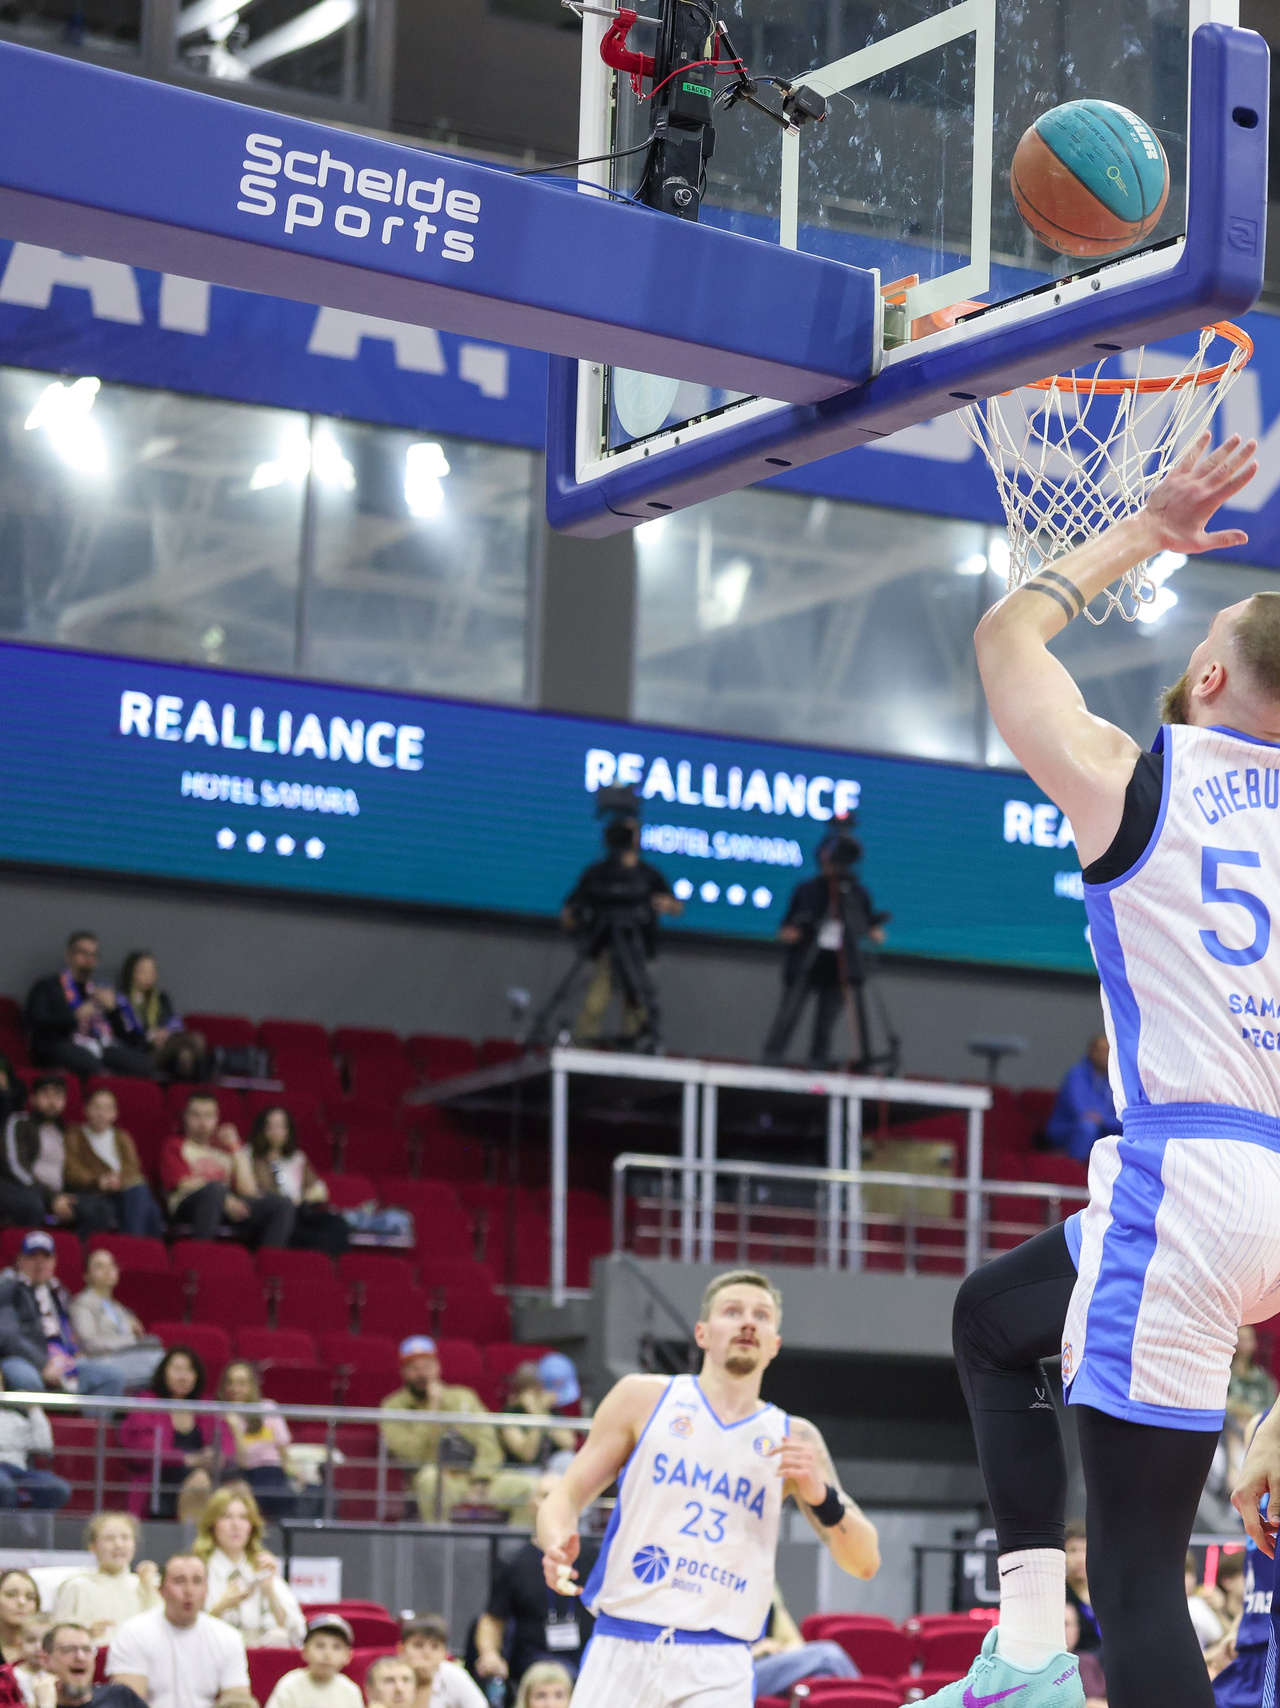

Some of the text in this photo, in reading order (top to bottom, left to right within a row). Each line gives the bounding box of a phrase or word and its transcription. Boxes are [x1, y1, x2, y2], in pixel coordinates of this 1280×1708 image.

[242, 133, 481, 224] Schelde
[237, 174, 475, 263] Sports
[120, 690, 425, 771] REALLIANCE
[585, 748, 861, 821] REALLIANCE
[653, 1453, 767, 1520] SAMARA
[678, 1501, 728, 1543] 23
[675, 1556, 747, 1594] РОССЕТИ
